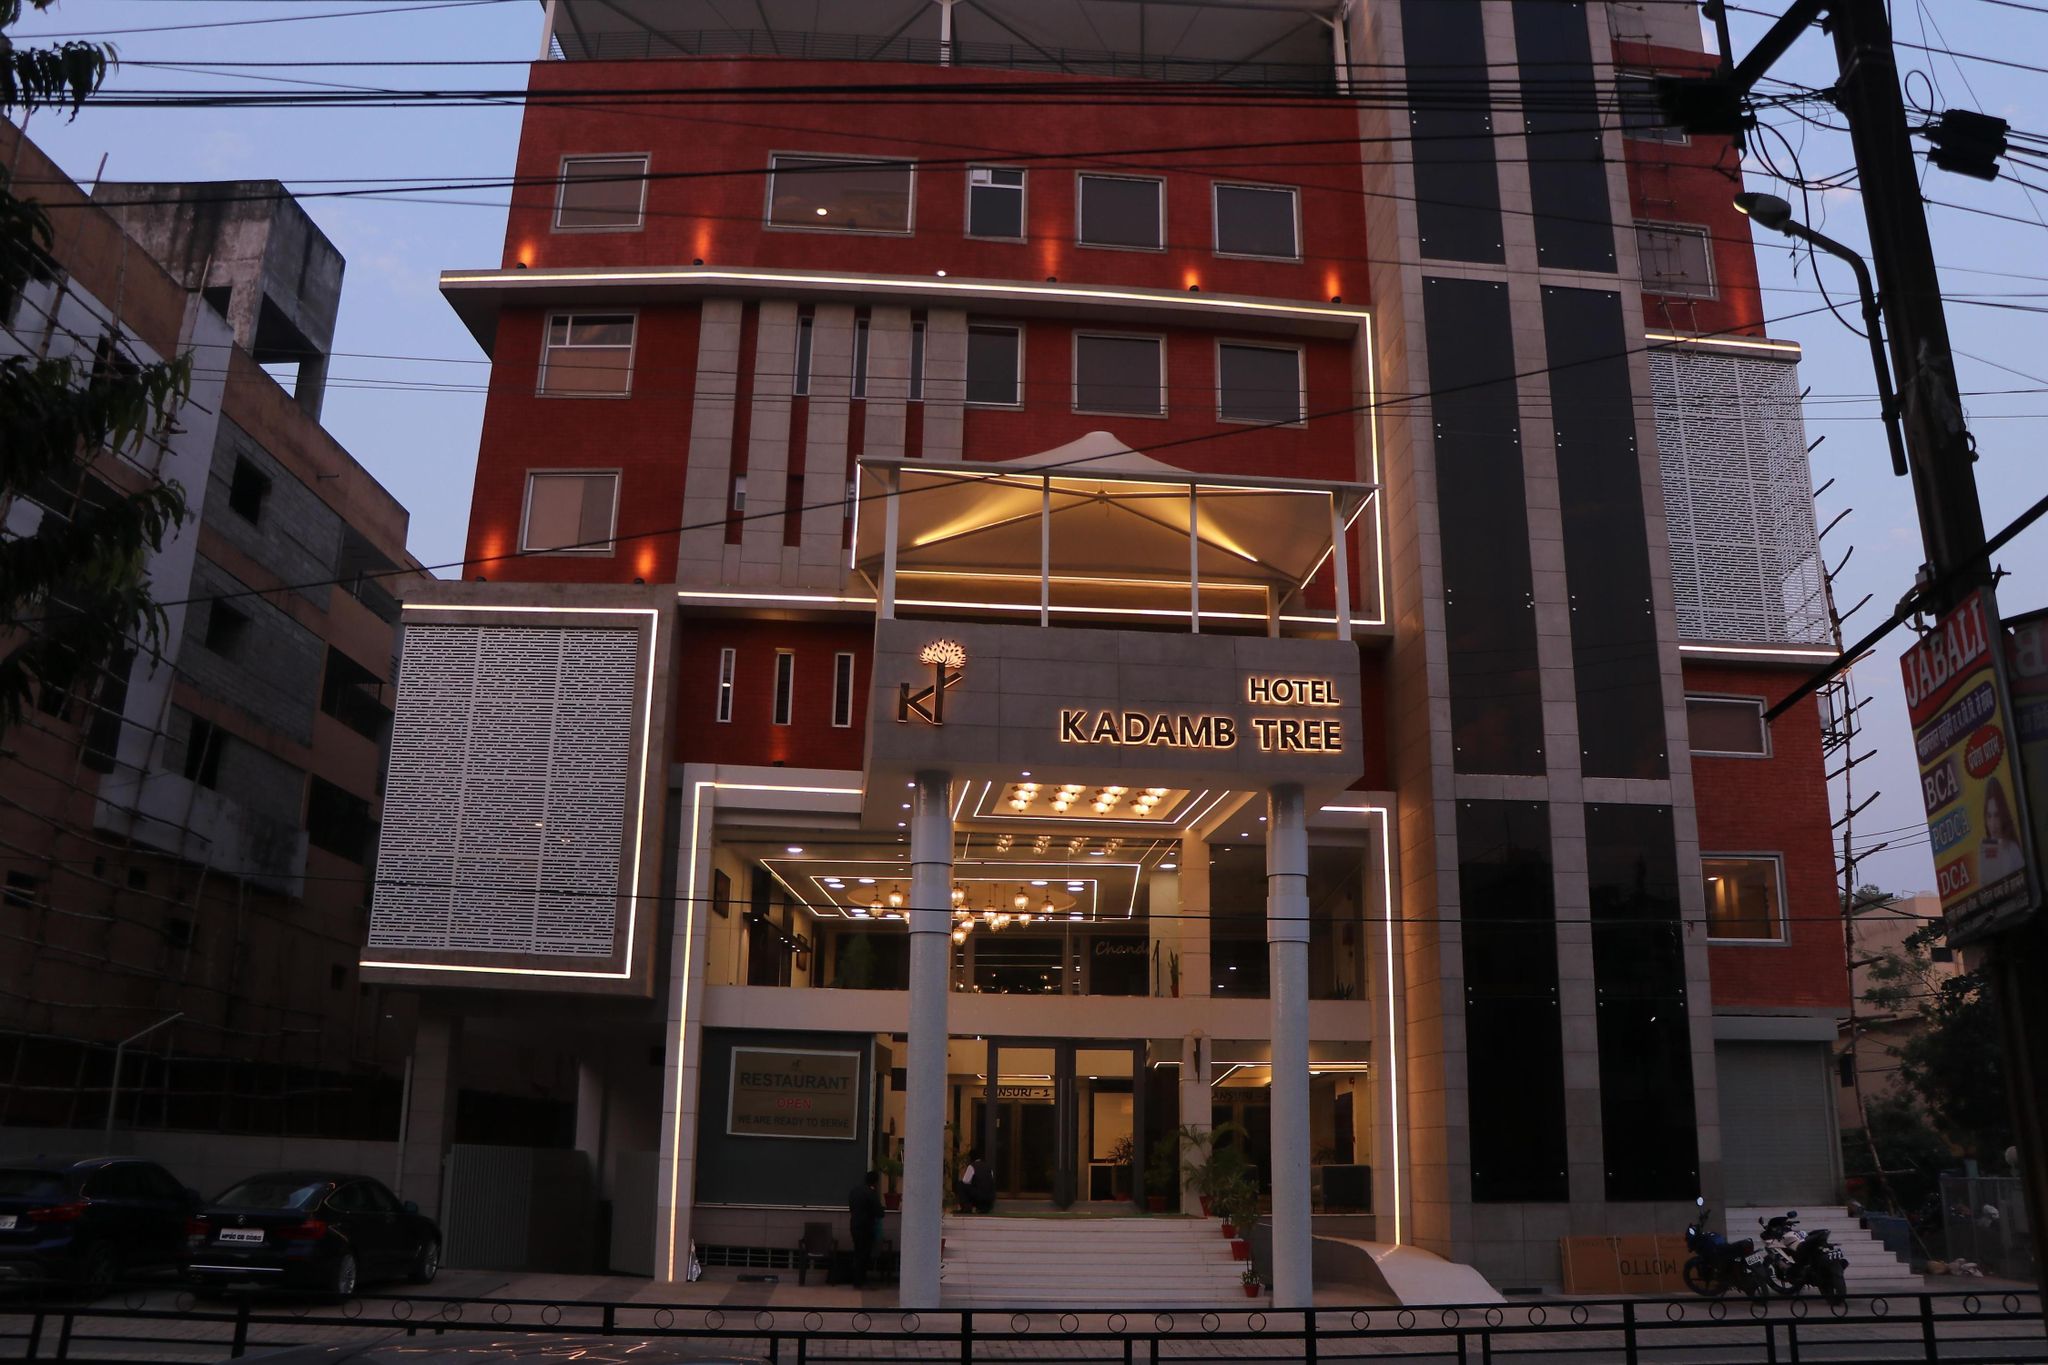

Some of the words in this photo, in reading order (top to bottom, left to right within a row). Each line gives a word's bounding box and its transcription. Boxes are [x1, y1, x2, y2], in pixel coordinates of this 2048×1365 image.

[1906, 597, 1987, 709] JABALI
[1248, 677, 1341, 706] HOTEL
[1059, 710, 1236, 748] KADAMB
[1253, 718, 1342, 752] TREE
[1924, 764, 1959, 811] BCA
[1931, 808, 1970, 851] PGDCA
[1939, 862, 1970, 897] DCA
[740, 1072, 850, 1090] RESTAURANT
[982, 1088, 1031, 1097] BNSURI
[776, 1098, 812, 1110] OPEN
[738, 1115, 751, 1124] WE
[752, 1115, 773, 1125] ARE
[774, 1116, 803, 1126] READY
[806, 1118, 818, 1127] TO
[820, 1118, 849, 1128] SERVE
